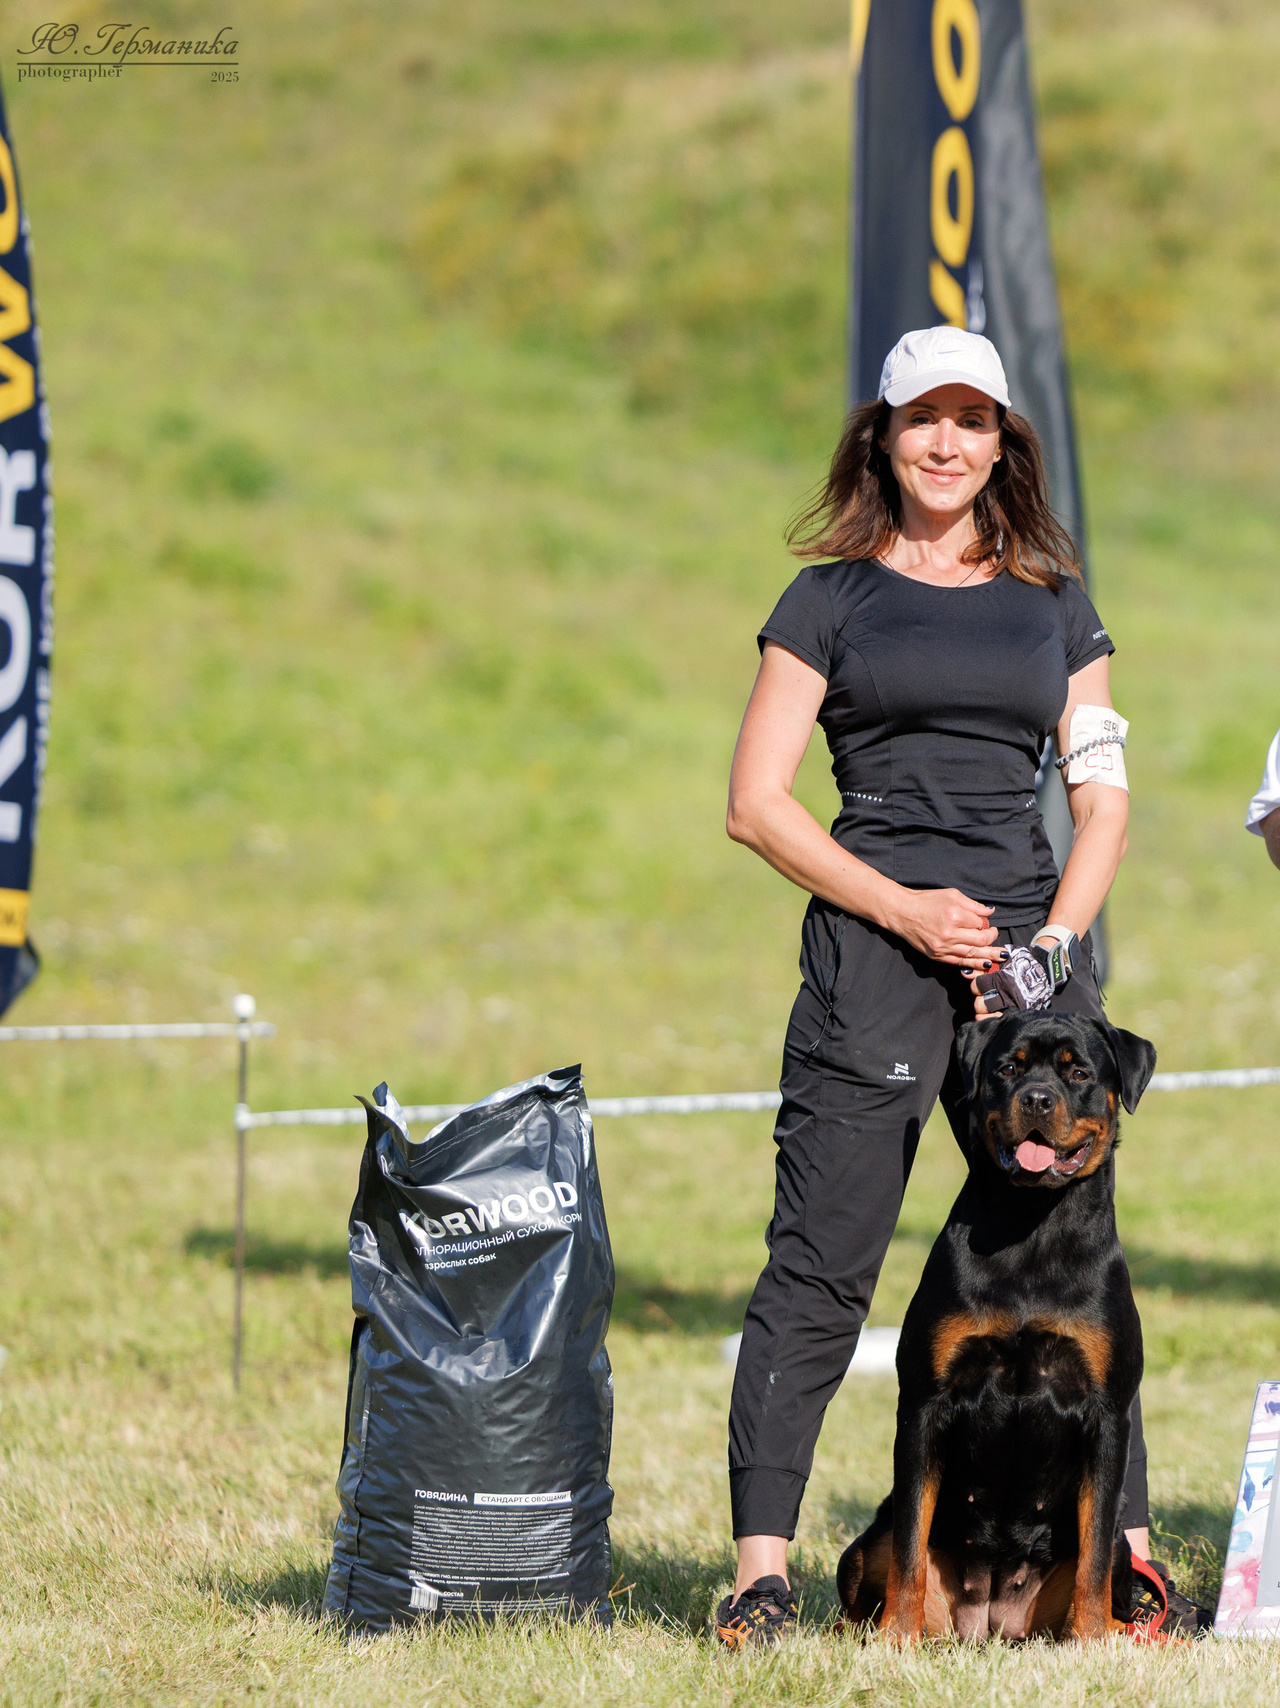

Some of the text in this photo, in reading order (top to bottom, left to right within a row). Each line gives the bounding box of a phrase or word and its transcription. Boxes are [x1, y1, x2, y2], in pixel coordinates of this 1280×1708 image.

[399, 1181, 578, 1239] KORWOOD
[415, 1231, 515, 1257] ЛНОРАЦИОННЫЙ
[516, 1217, 556, 1240] СУХОЙ
[468, 1252, 497, 1266] собак
[414, 1489, 468, 1503] ГОВЯДИНА
[481, 1496, 523, 1504] СТАНДАРТ
[531, 1494, 567, 1503] ОВОЩАМИ
